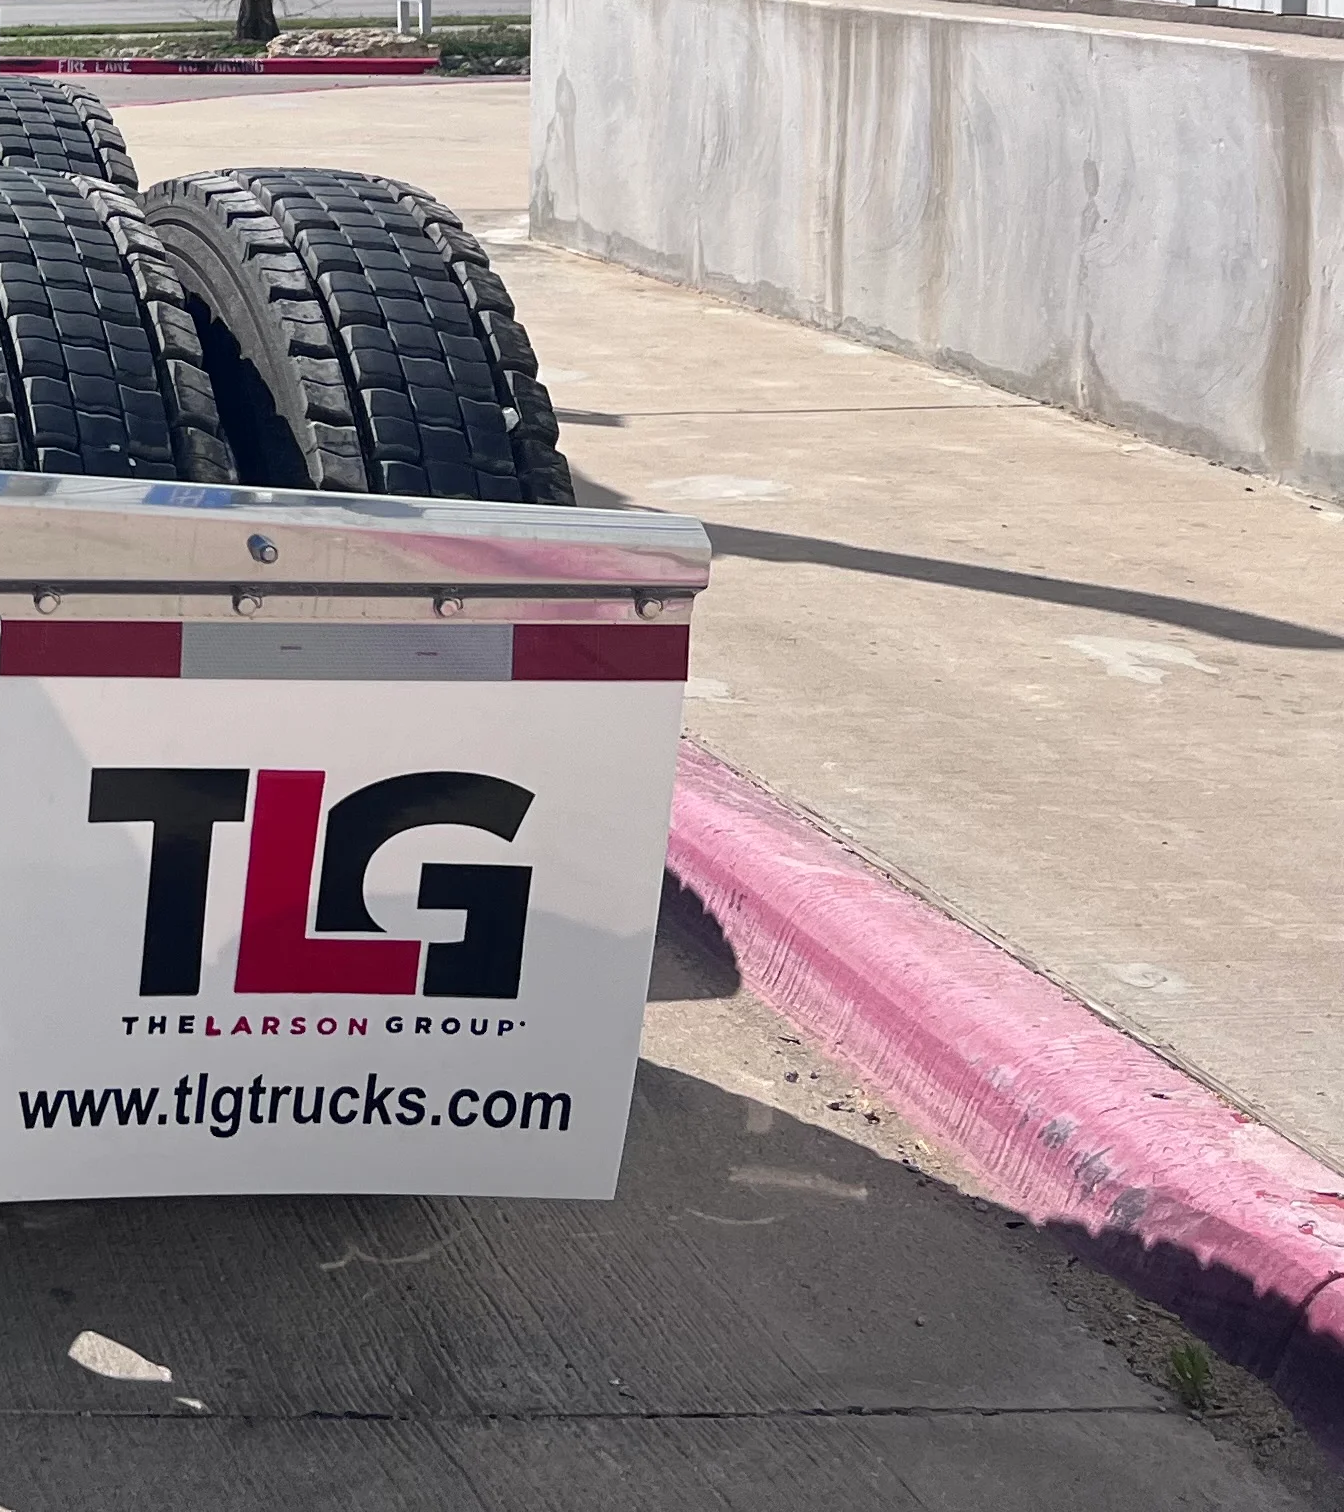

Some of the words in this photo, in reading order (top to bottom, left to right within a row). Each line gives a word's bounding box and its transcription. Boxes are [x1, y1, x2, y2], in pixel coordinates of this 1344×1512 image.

[57, 59, 88, 74] FIRE
[95, 61, 133, 73] LANE
[88, 768, 535, 999] TLG
[386, 1016, 515, 1036] GROUP
[19, 1072, 572, 1139] www.tlgtrucks.com
